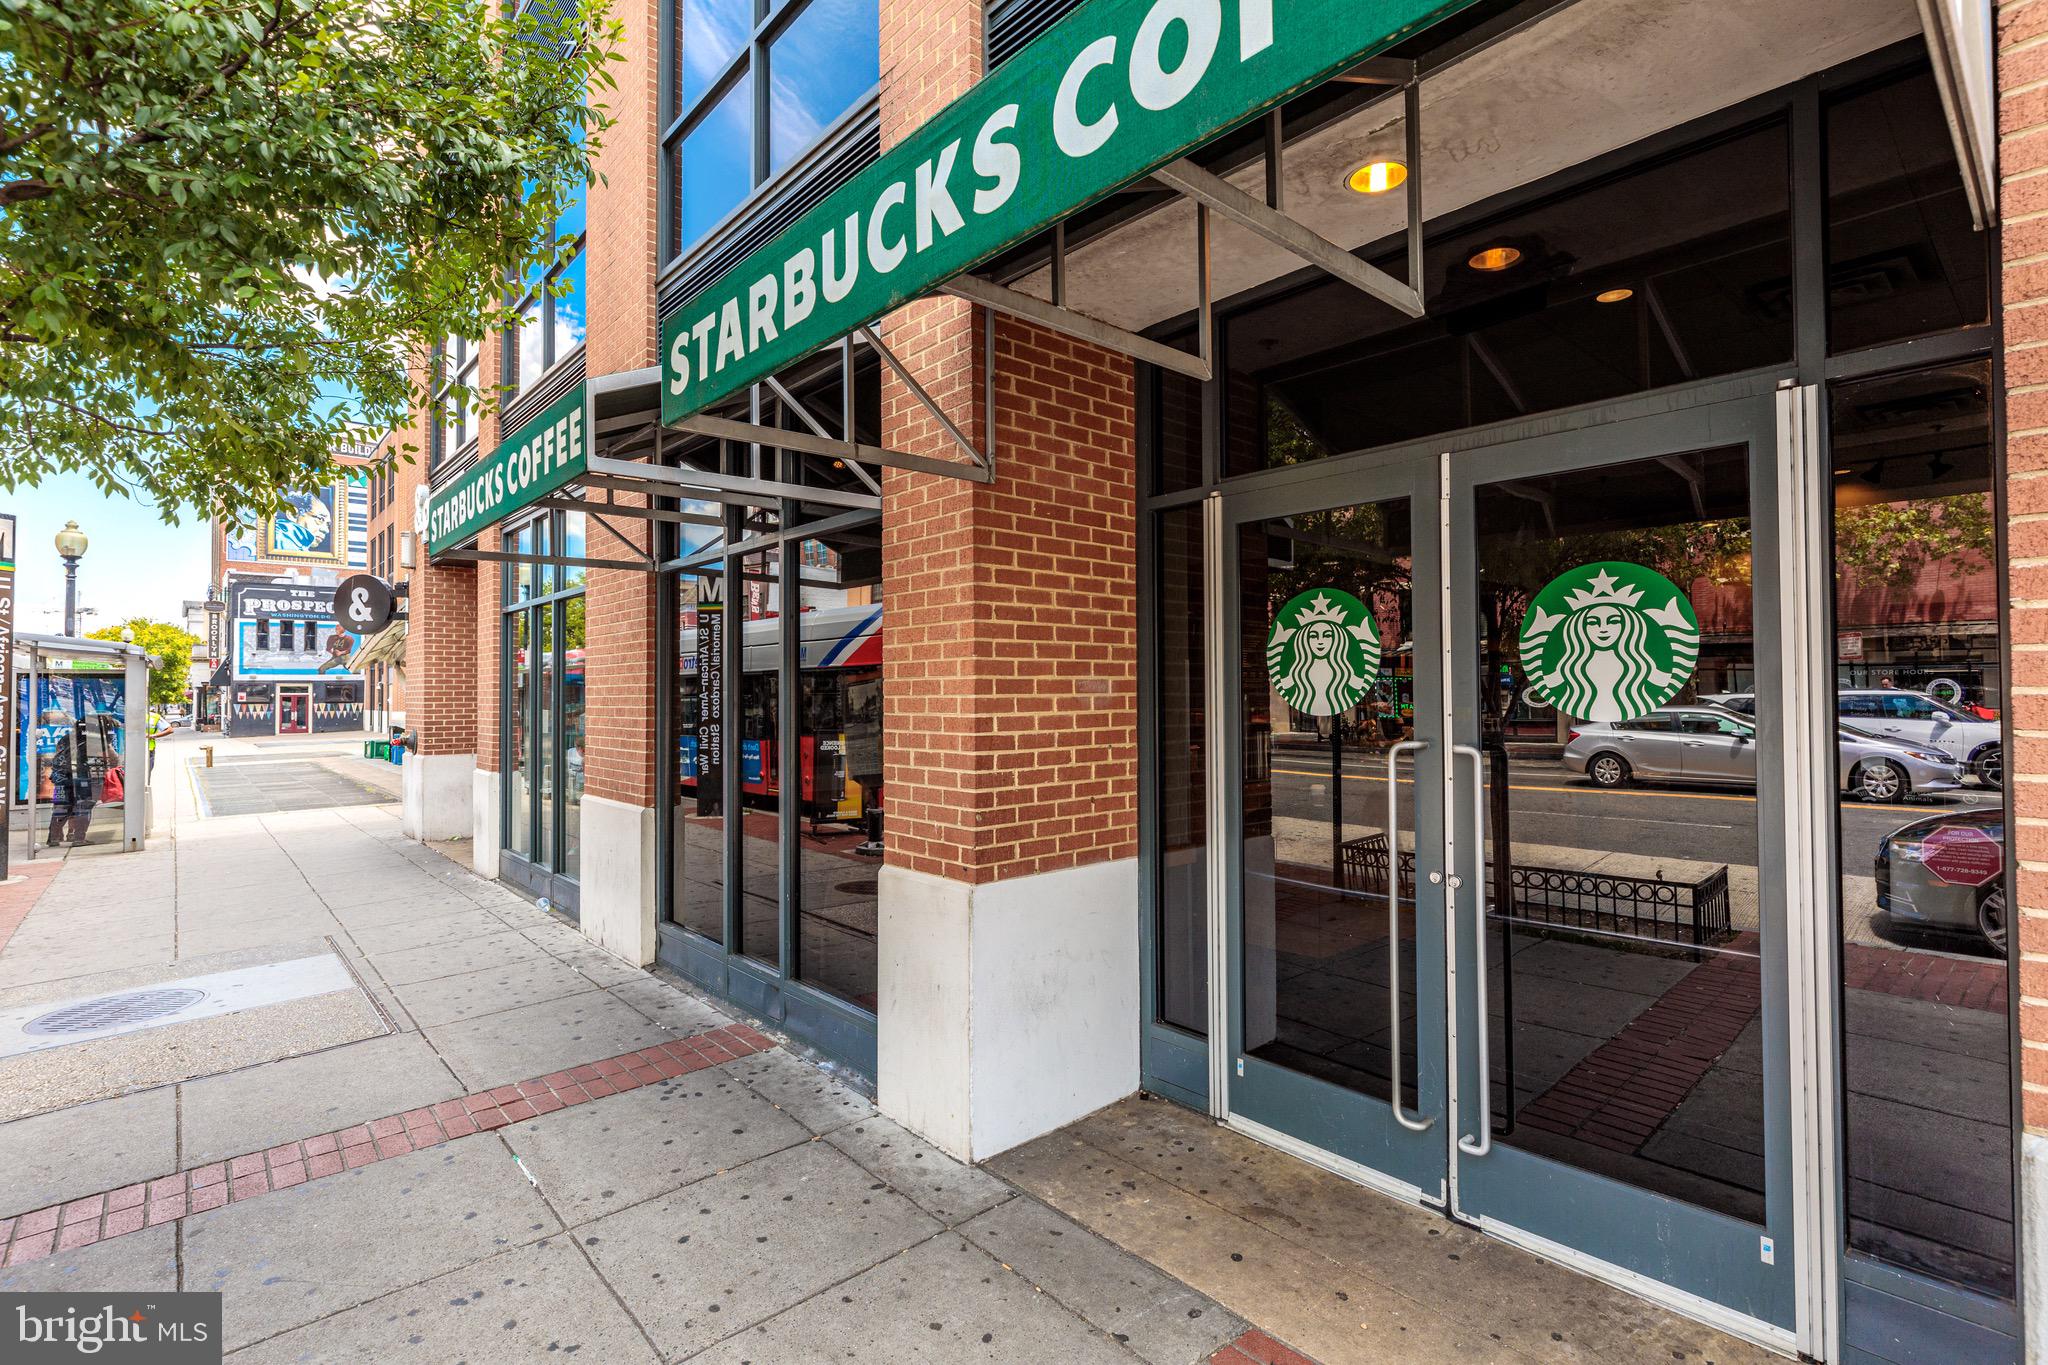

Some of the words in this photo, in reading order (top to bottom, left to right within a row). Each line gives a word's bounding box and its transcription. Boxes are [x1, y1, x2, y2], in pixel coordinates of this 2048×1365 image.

[670, 104, 1021, 396] STARBUCKS
[431, 462, 504, 543] STARBUCKS
[506, 406, 582, 495] COFFEE
[211, 613, 219, 657] BROOKLYN
[290, 590, 315, 598] THE
